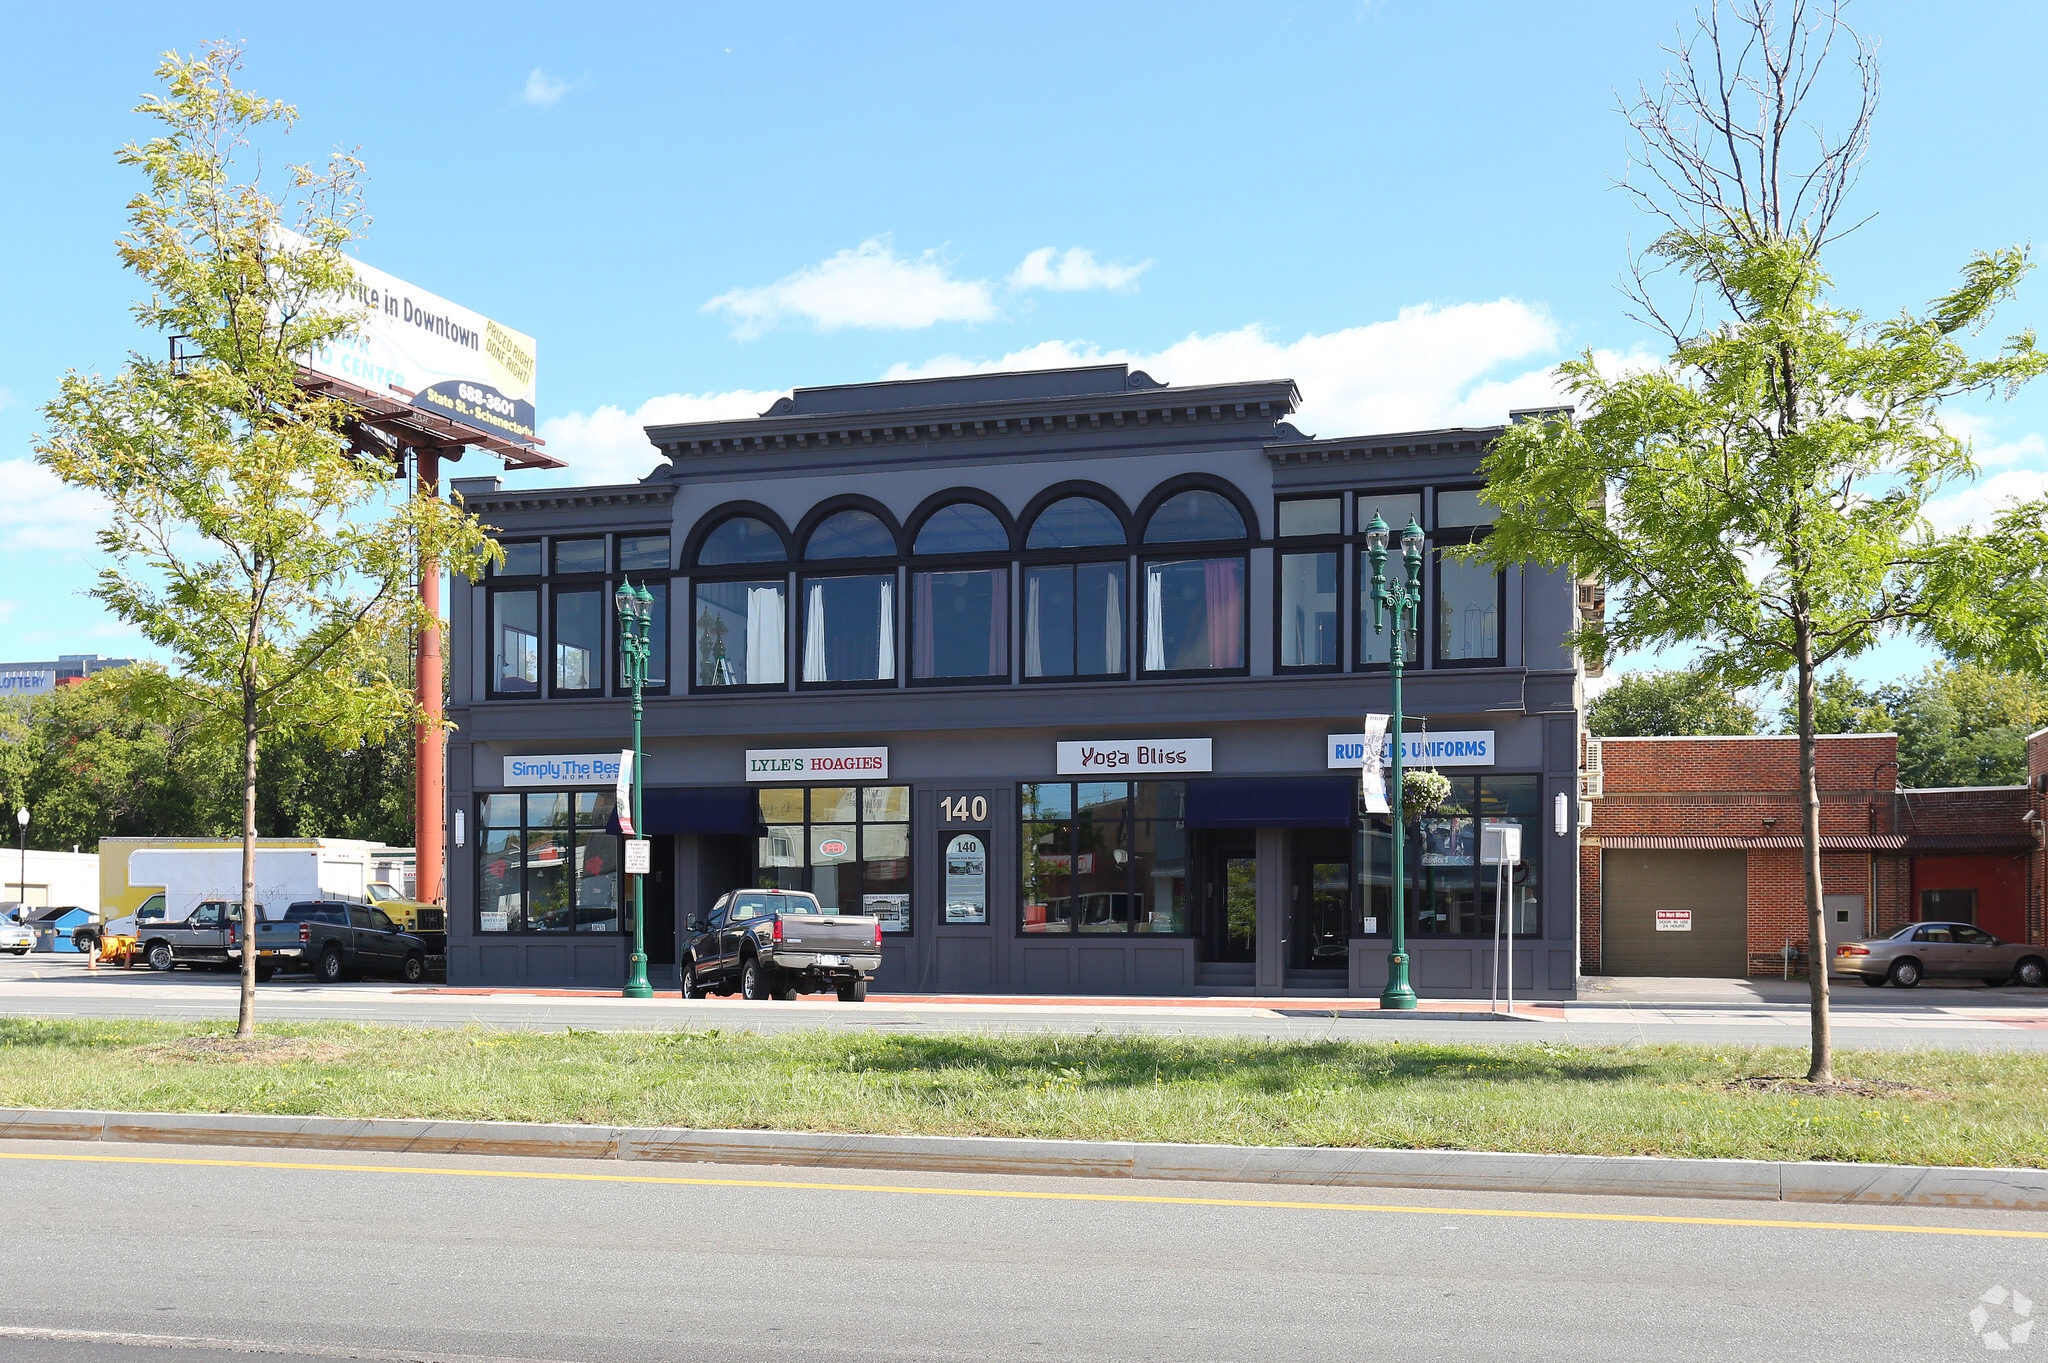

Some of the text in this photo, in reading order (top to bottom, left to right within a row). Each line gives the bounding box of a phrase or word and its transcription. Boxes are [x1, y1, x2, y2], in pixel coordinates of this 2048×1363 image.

[385, 288, 398, 318] in
[403, 297, 479, 351] Downtown
[486, 320, 512, 353] PRICED
[485, 338, 530, 388] DONE RIGHT!
[427, 388, 454, 409] State
[458, 383, 515, 418] 688-3601
[1081, 746, 1187, 768] Yoga Bliss
[1411, 740, 1486, 758] UNIFORMS
[512, 760, 620, 779] Simply The Bes
[751, 756, 883, 772] LYLE'S HOAGIES
[940, 795, 988, 822] 140
[822, 842, 845, 853] OPEN
[956, 841, 976, 853] 140
